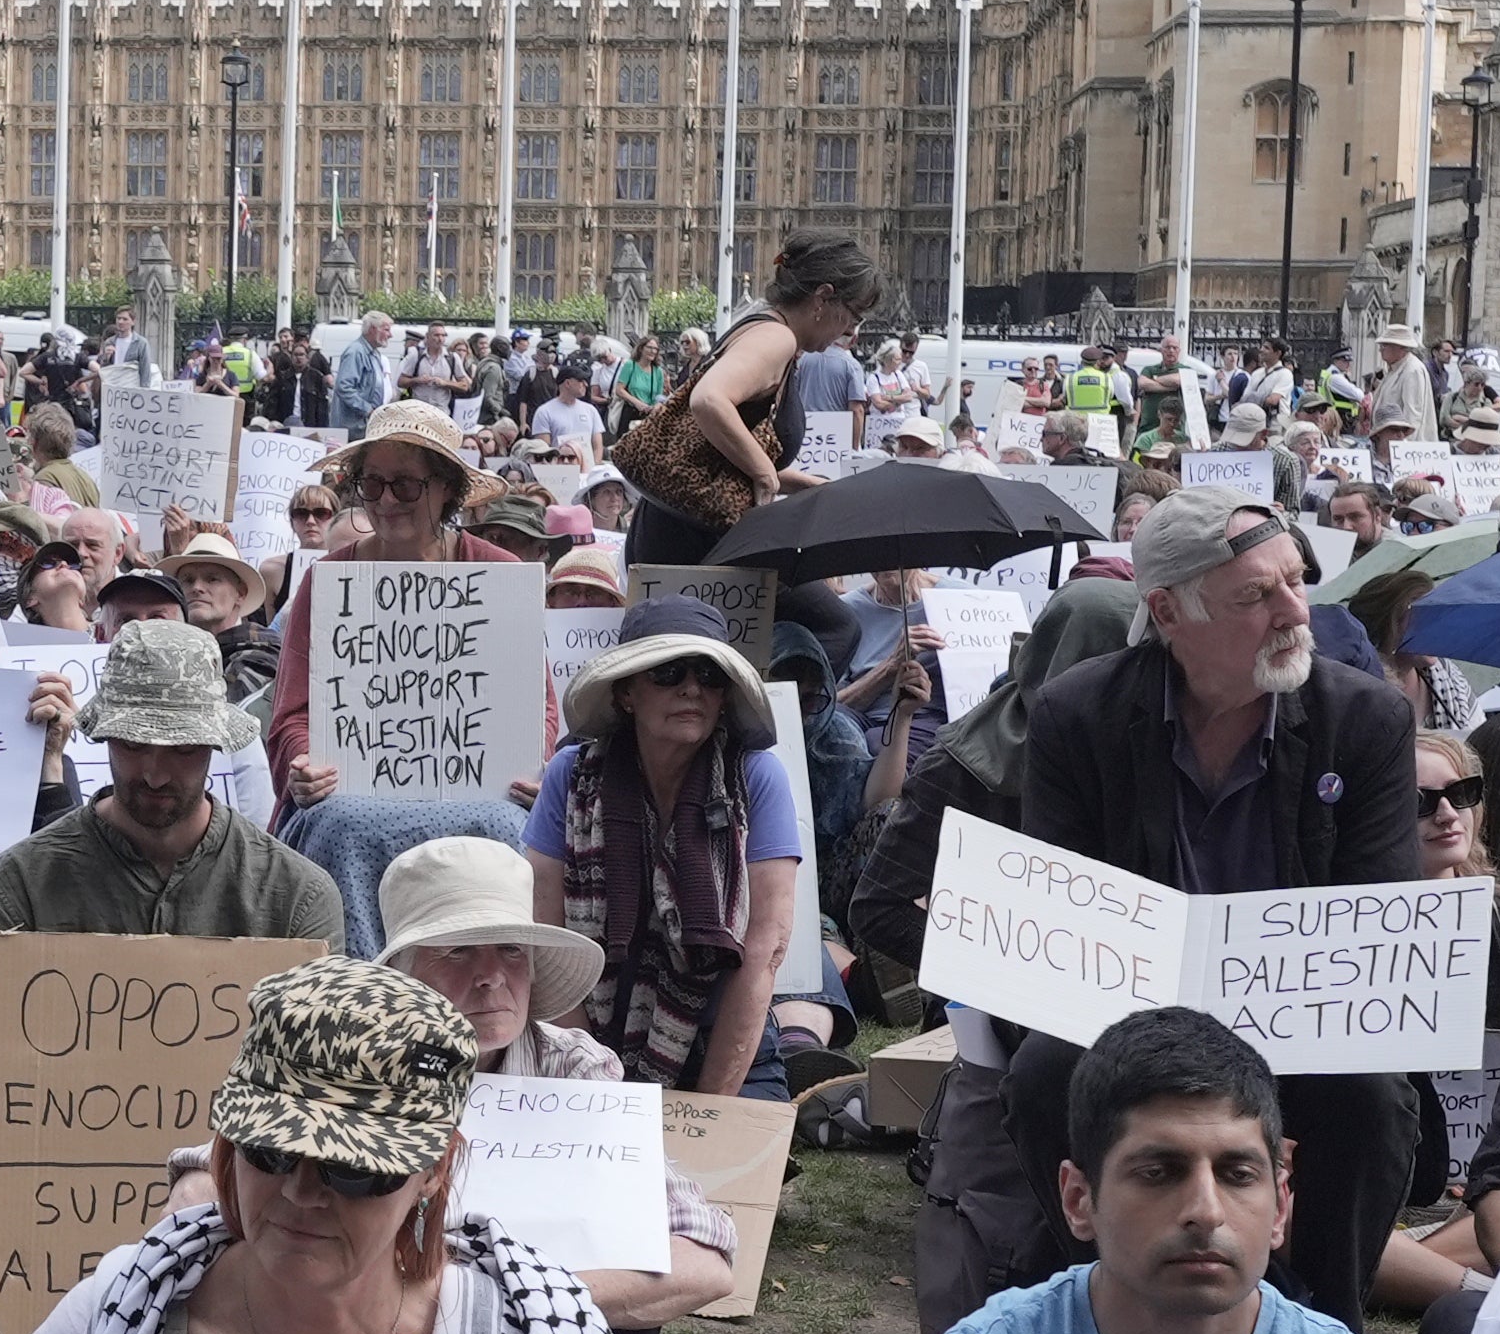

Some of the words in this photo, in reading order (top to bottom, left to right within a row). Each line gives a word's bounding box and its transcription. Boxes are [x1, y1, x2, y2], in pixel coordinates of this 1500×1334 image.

[105, 387, 181, 415] OPPOSE
[104, 414, 204, 440] GENOCIDE
[103, 456, 201, 489] PALESTINE
[1197, 461, 1254, 482] OPPOSE
[115, 479, 219, 517] ACTION
[338, 577, 354, 617] I
[375, 570, 488, 611] OPPOSE
[332, 618, 490, 667] GENOCIDE
[331, 675, 347, 710] I
[363, 670, 490, 708] SUPPORT
[335, 708, 491, 760] PALESTINE
[372, 751, 486, 789] ACTION
[997, 850, 1164, 932] OPPOSE
[1260, 888, 1486, 940] SUPPORT
[929, 887, 1161, 1006] GENOCIDE
[1220, 937, 1482, 999] PALESTINE
[1226, 990, 1440, 1041] ACTION
